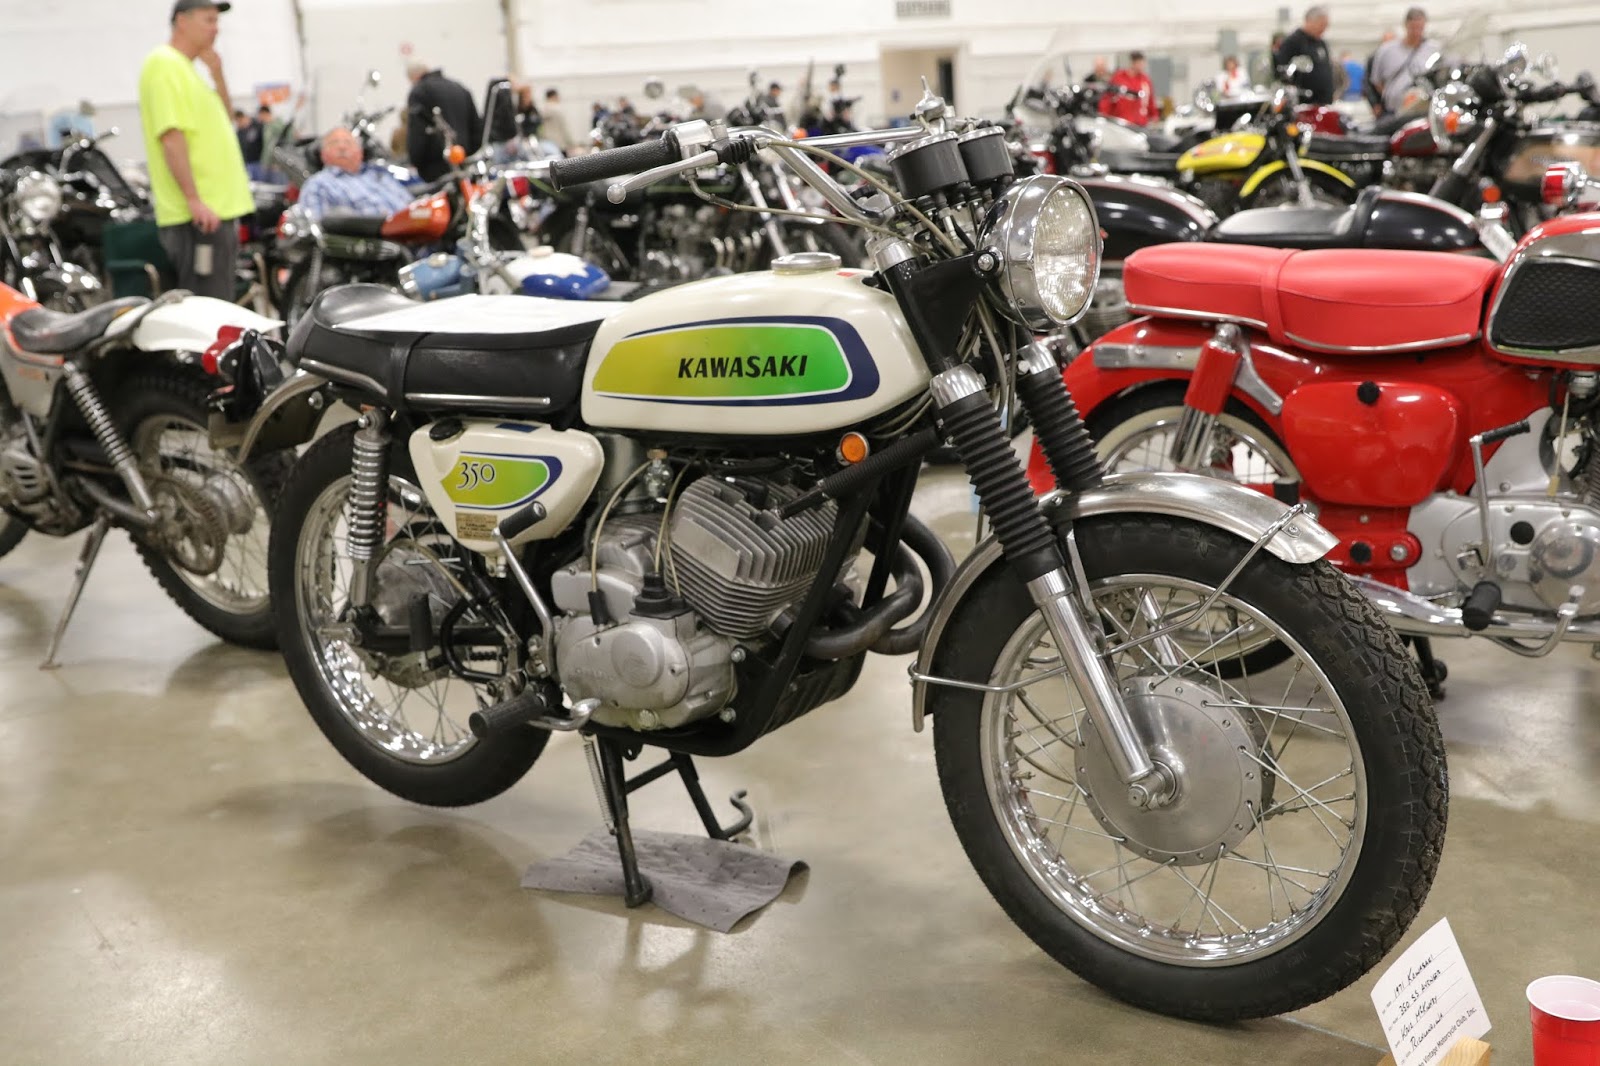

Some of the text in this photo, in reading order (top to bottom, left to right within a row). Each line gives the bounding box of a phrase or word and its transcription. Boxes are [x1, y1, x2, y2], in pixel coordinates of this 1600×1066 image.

[678, 355, 808, 379] KAWASAKI
[457, 462, 495, 490] 350
[1399, 1001, 1410, 1016] 350
[1423, 1045, 1438, 1064] Vintage
[1437, 1023, 1458, 1048] Motorcycle
